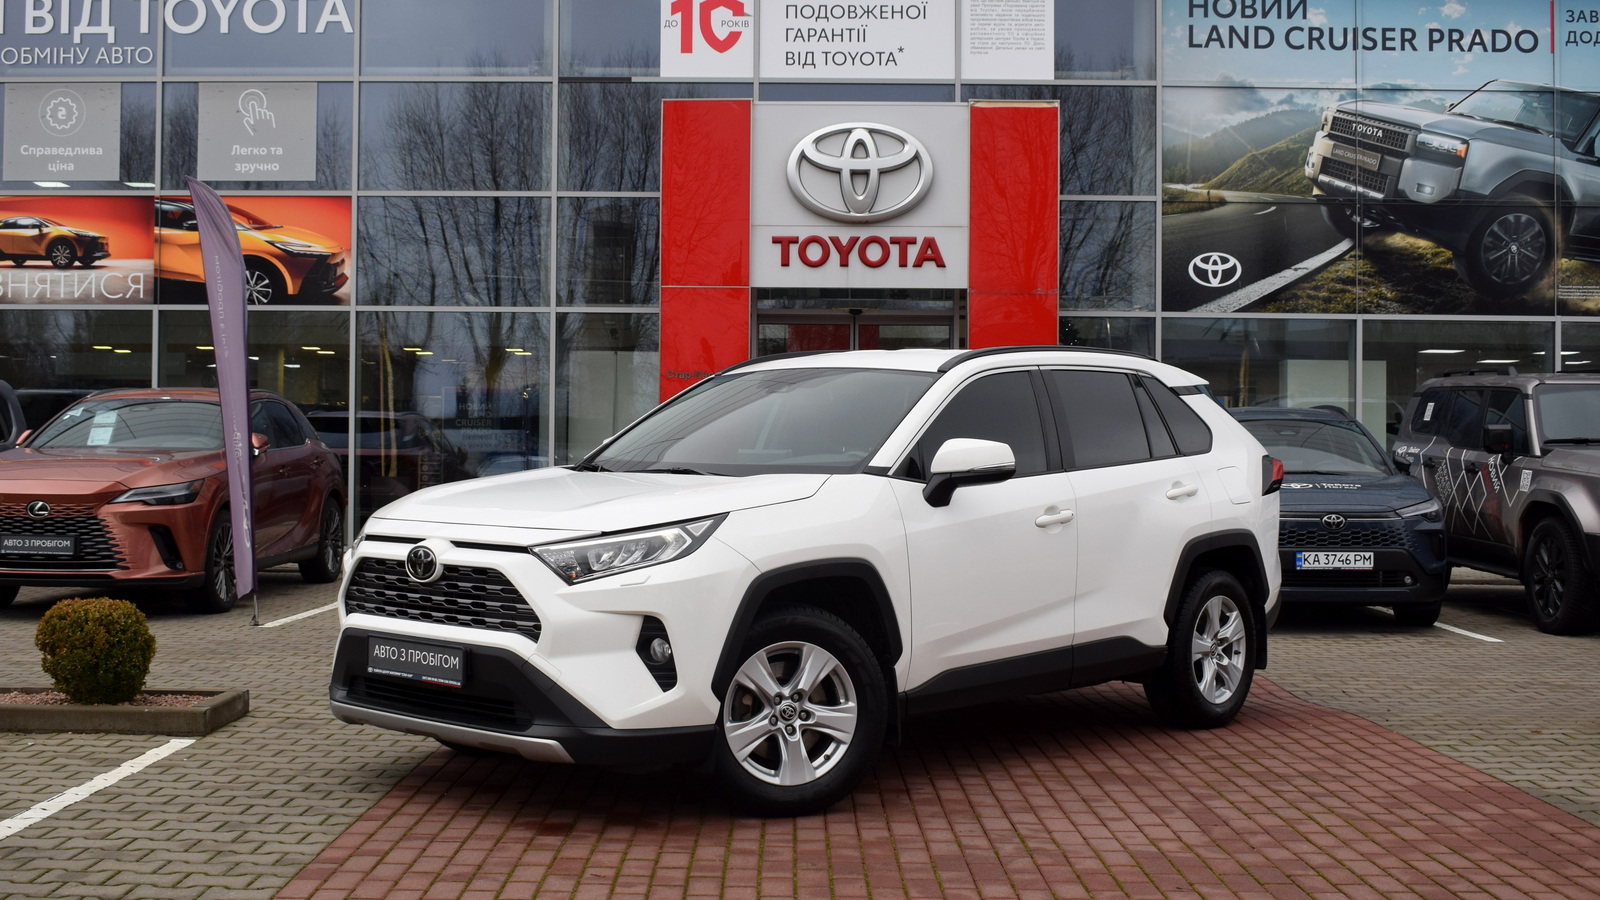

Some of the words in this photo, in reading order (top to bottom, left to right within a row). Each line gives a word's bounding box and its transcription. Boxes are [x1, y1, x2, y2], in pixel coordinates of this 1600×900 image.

[784, 2, 928, 24] ПОДОВЖЕНОЇ
[24, 0, 116, 44] ВІД
[139, 0, 354, 35] TOYOTA
[664, 19, 679, 29] ДО
[721, 19, 750, 28] РОКІВ
[784, 24, 867, 44] ГАРАНТІЇ
[1188, 25, 1275, 50] LAND
[1284, 26, 1418, 52] CRUISER
[1428, 28, 1539, 54] PRADO
[1, 46, 90, 65] ОБМІНУ
[95, 46, 154, 65] АВТО
[784, 51, 817, 70] ВІД
[1352, 124, 1383, 137] TOYOTA
[20, 144, 103, 158] Справедлива
[231, 144, 267, 156] Легко
[270, 146, 283, 156] та
[47, 159, 75, 174] ціна
[234, 161, 280, 174] зручно
[771, 234, 947, 268] TOYOTA
[0, 271, 144, 299] НЯТИСЯ
[455, 418, 492, 426] CRUISER
[3, 539, 23, 547] АВТО
[31, 540, 70, 548] ПРОБІГОМ
[1303, 553, 1321, 565] KA
[1323, 553, 1352, 565] 3746
[1354, 553, 1372, 565] PM
[373, 644, 398, 660] АВТО
[399, 648, 406, 661] З
[408, 649, 459, 669] ПРОБІГОМ
